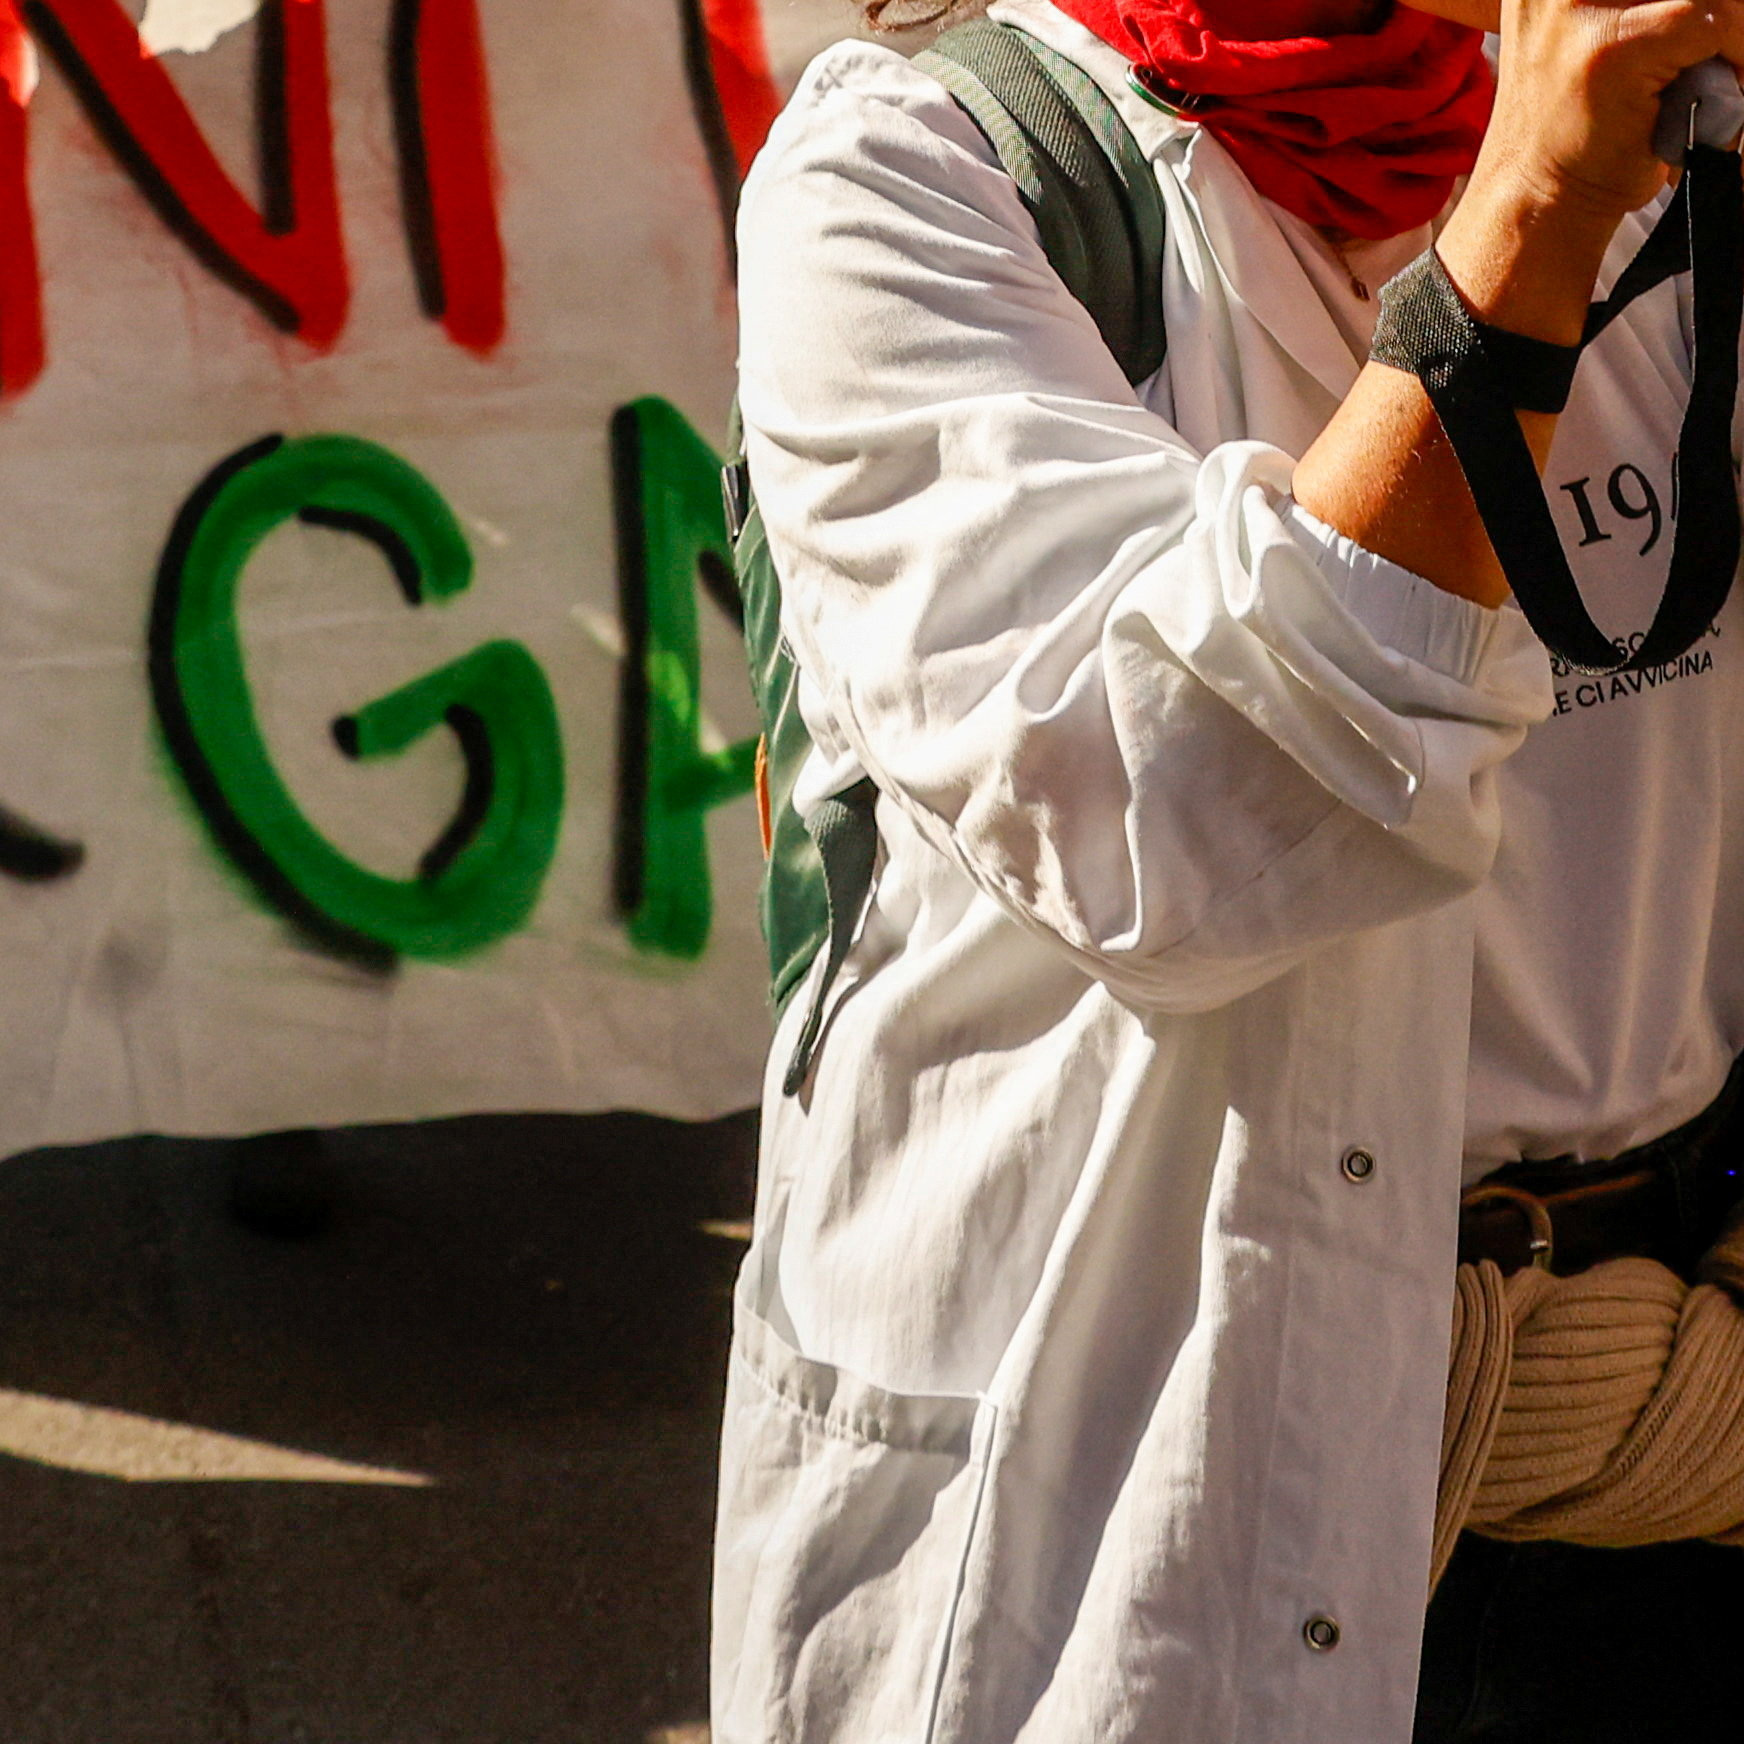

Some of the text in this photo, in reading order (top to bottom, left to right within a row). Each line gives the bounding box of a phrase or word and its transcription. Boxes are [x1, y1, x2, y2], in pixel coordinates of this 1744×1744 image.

[1559, 452, 1679, 557] 19
[1575, 681, 1605, 708] CI
[1610, 650, 1714, 701] AVVICINA
